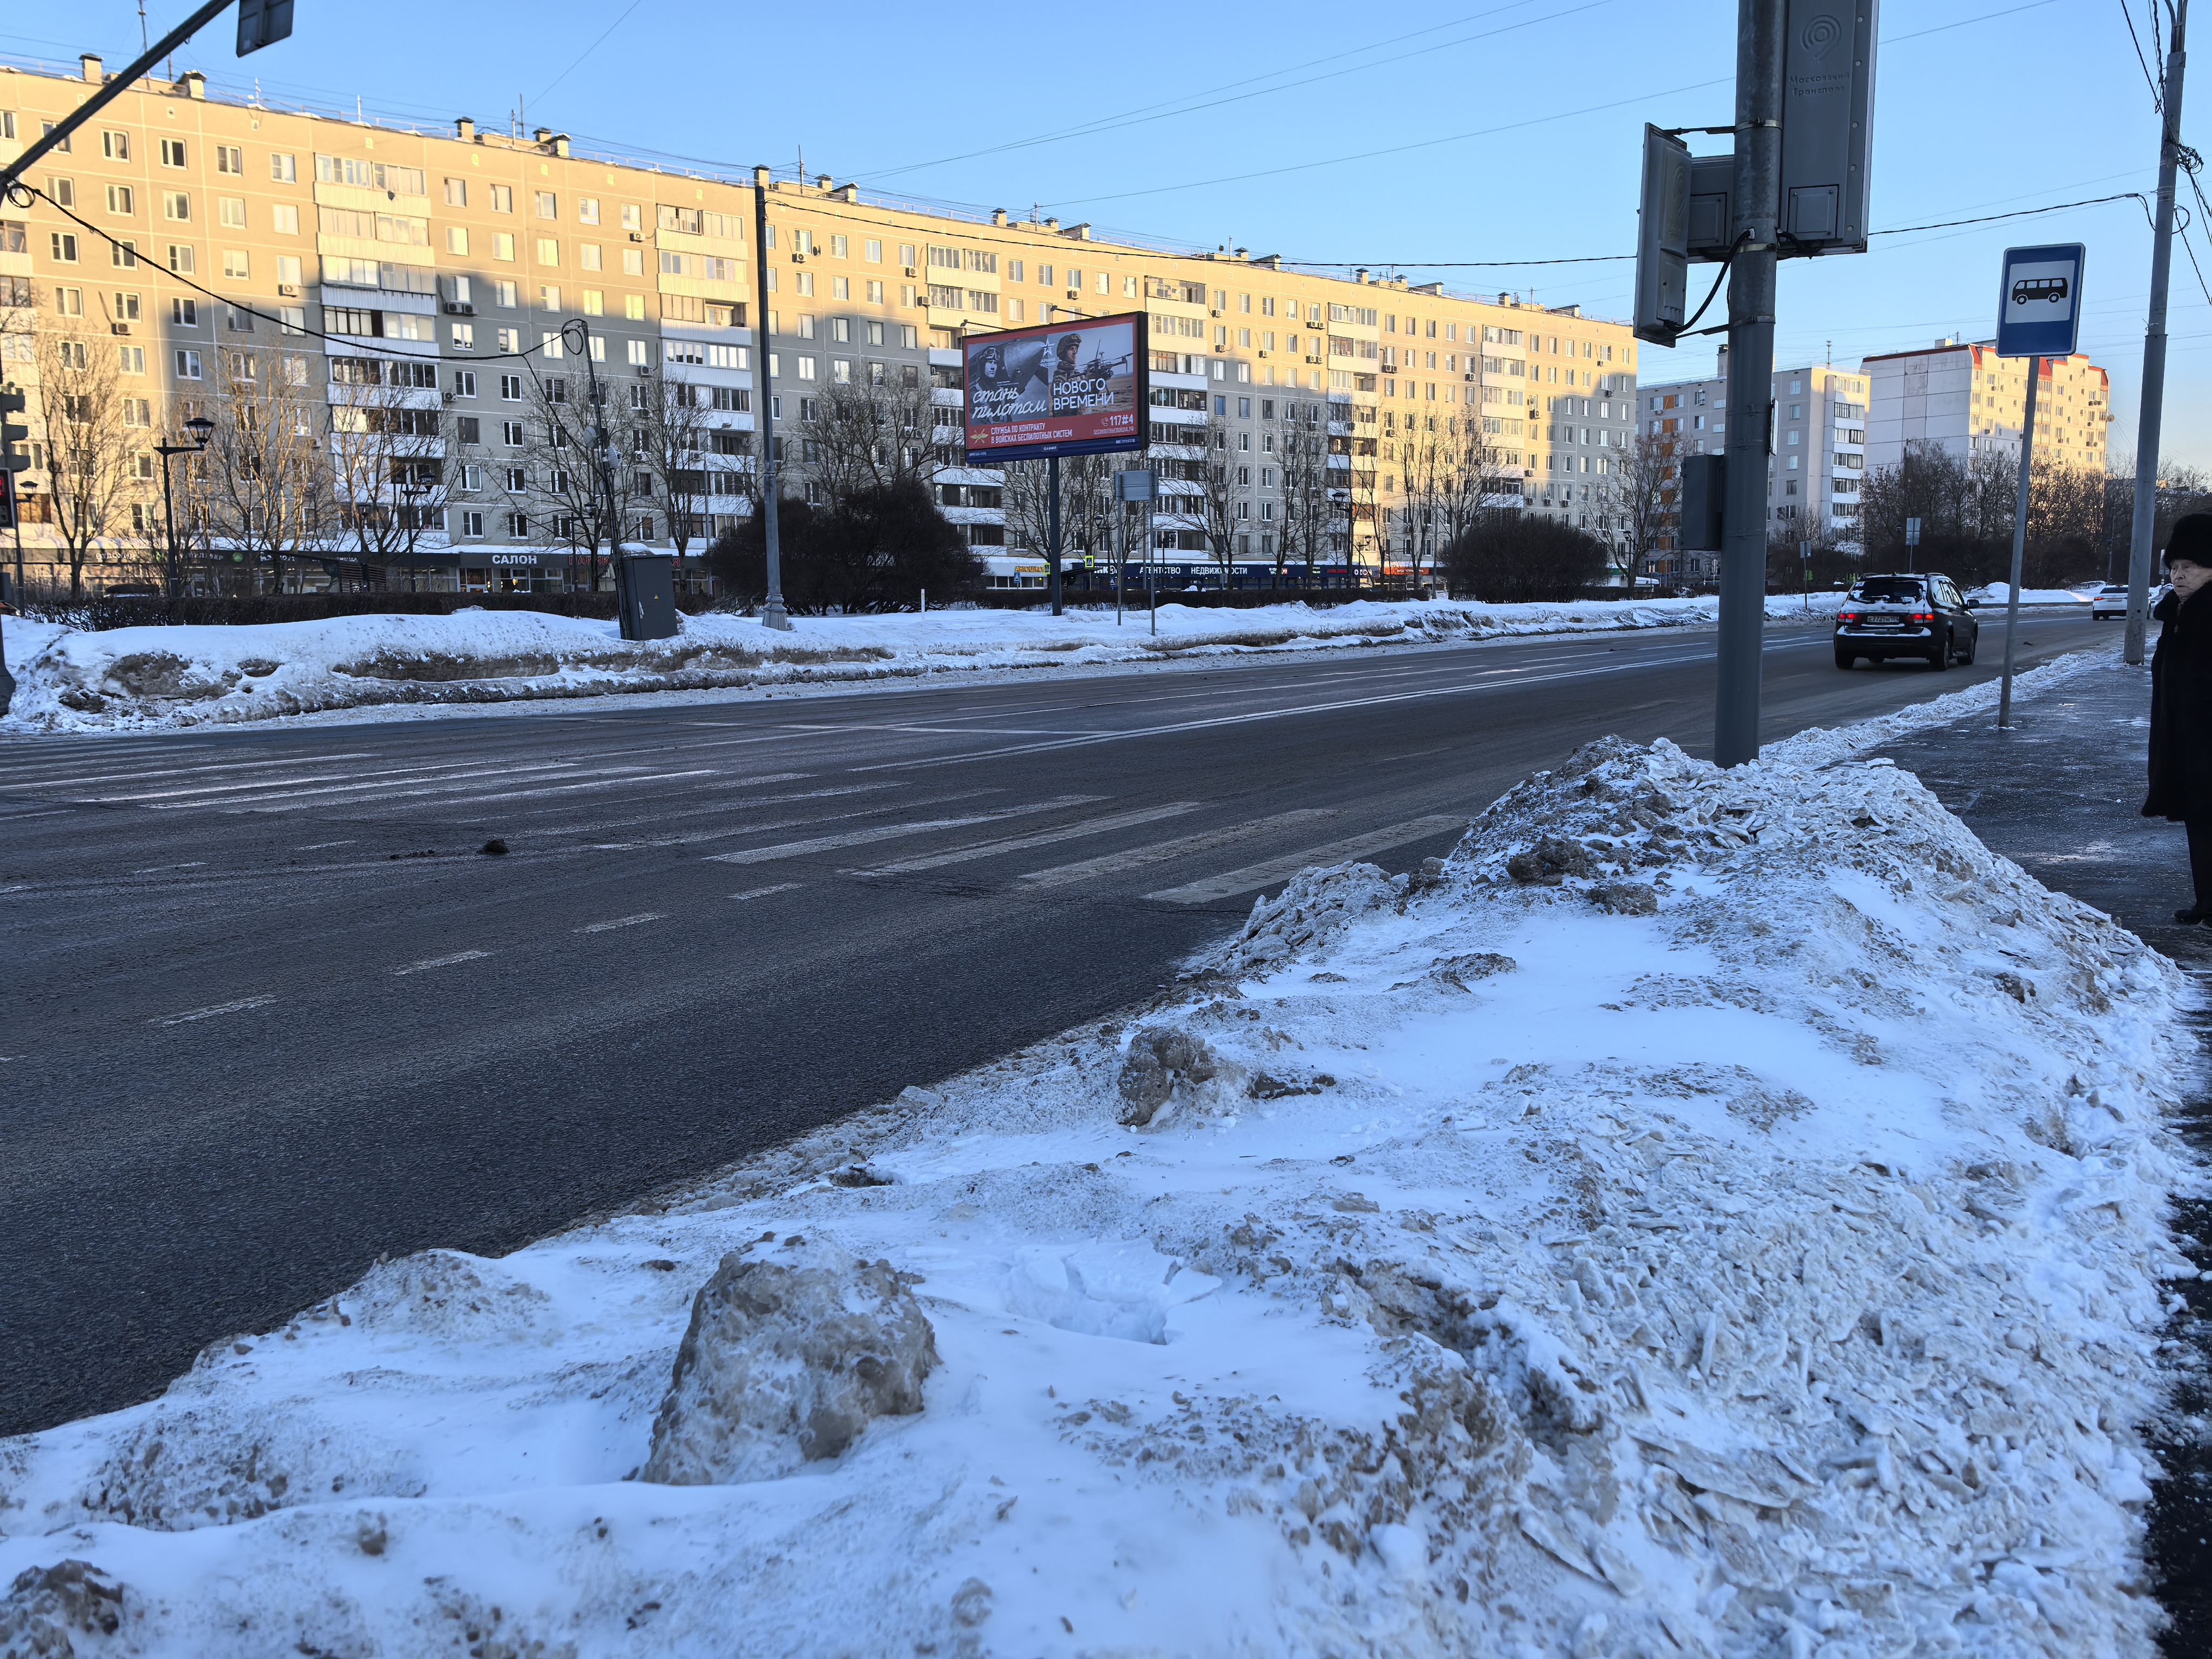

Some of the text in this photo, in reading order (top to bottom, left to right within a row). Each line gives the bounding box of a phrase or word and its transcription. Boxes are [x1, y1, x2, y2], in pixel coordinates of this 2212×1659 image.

[1053, 378, 1106, 396] НОВОГО
[1053, 392, 1114, 410] ВРЕМЕНИ
[972, 400, 1047, 419] пилотом
[1110, 414, 1134, 426] 117#4
[991, 426, 1011, 435] СЛУЖБА
[1019, 422, 1046, 432] КОНТРАКТУ
[995, 434, 1017, 443] ВОЙСКАХ
[1017, 431, 1053, 442] БЕСПИЛОТНЫХ
[1053, 429, 1073, 438] СИСТЕМ
[492, 555, 537, 564] САЛОН
